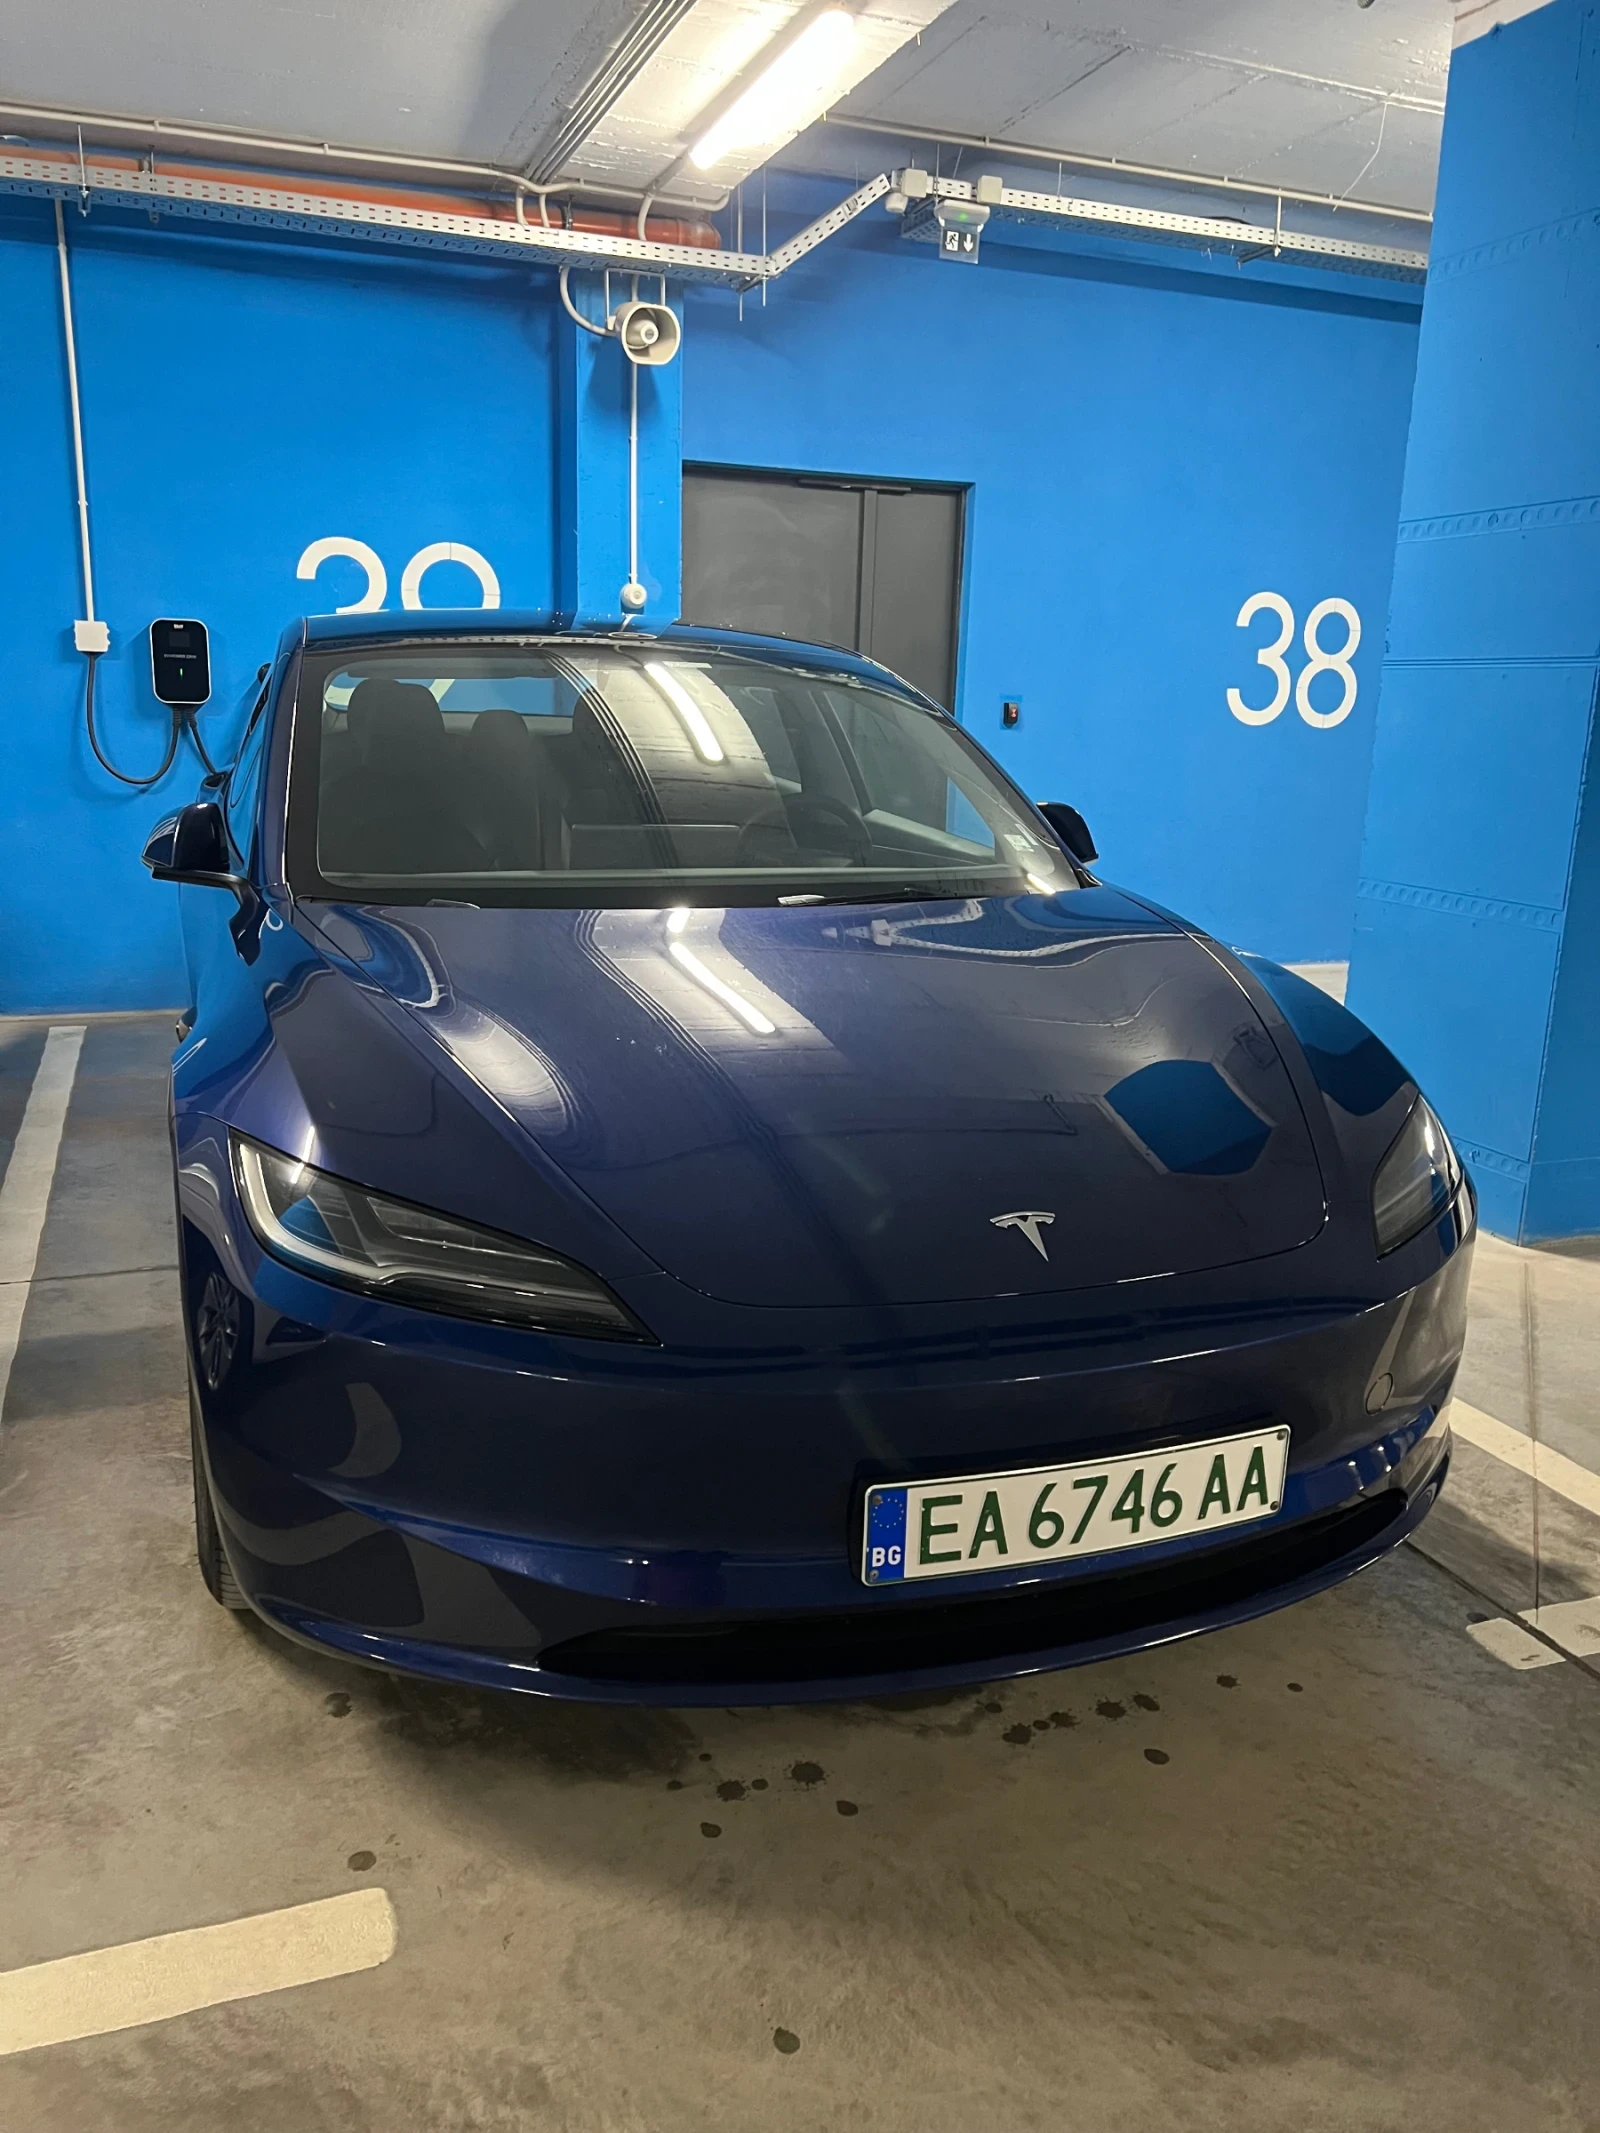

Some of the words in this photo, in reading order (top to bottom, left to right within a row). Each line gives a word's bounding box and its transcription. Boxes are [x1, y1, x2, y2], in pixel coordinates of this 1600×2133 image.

[1226, 591, 1361, 729] 38
[871, 1546, 902, 1567] BG
[919, 1490, 1008, 1565] EA
[1028, 1462, 1184, 1549] 6746
[1197, 1446, 1269, 1520] AA
